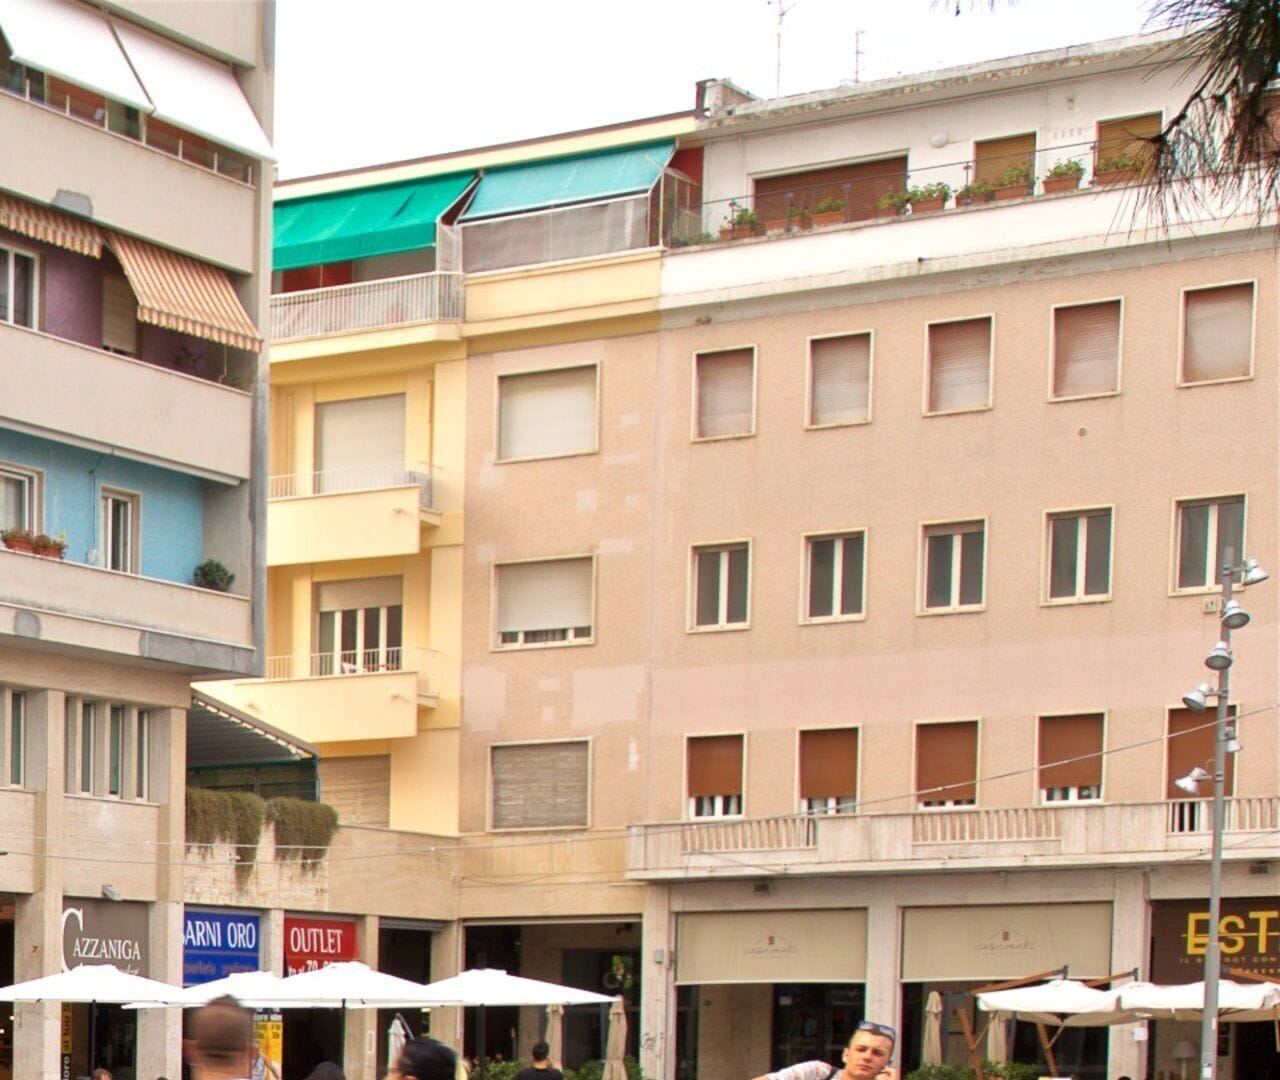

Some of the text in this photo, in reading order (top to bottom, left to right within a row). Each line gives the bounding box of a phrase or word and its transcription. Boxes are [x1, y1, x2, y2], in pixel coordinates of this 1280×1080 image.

[227, 922, 257, 949] ORO
[290, 926, 344, 954] OUTLET
[1182, 910, 1280, 955] EST
